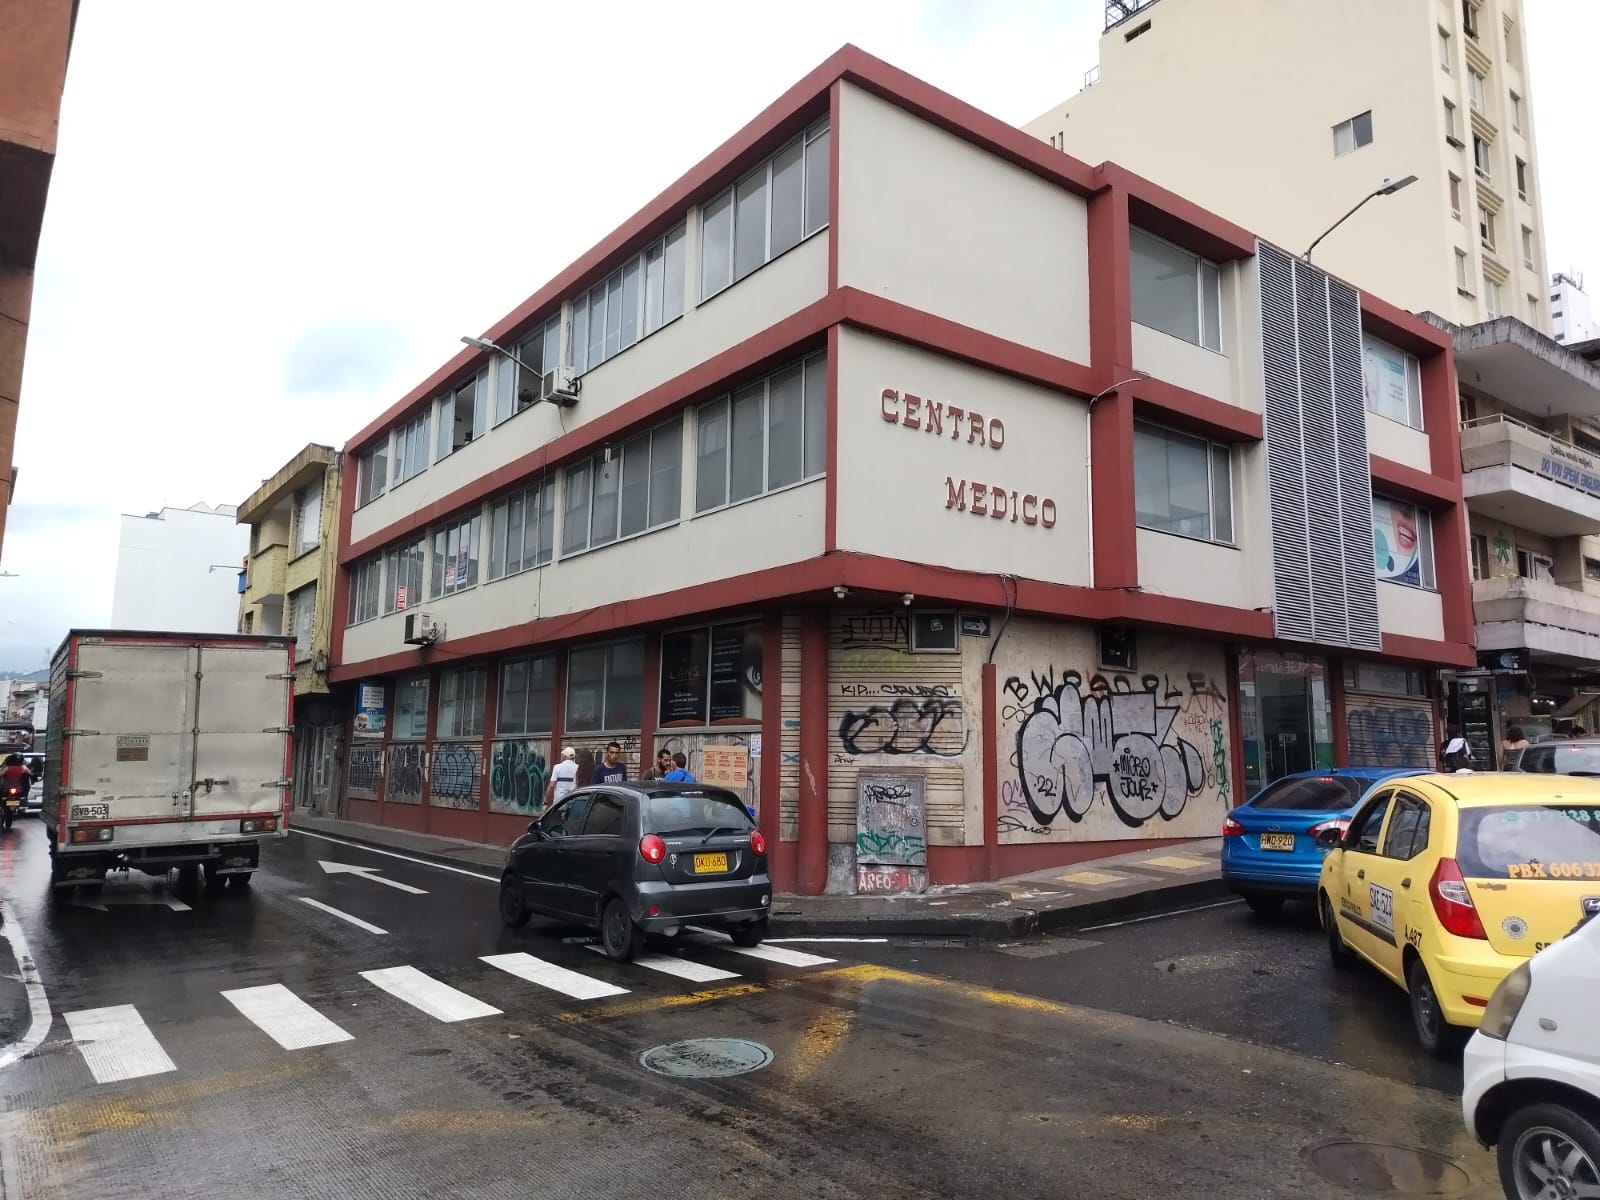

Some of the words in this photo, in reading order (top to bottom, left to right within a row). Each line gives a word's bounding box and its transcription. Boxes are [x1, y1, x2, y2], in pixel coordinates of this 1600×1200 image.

[881, 388, 1005, 449] CENTRO
[1541, 457, 1551, 473] DO
[1552, 461, 1563, 478] YOU
[944, 476, 1057, 528] MEDICO
[1508, 862, 1548, 878] PBX
[1550, 862, 1582, 878] 606
